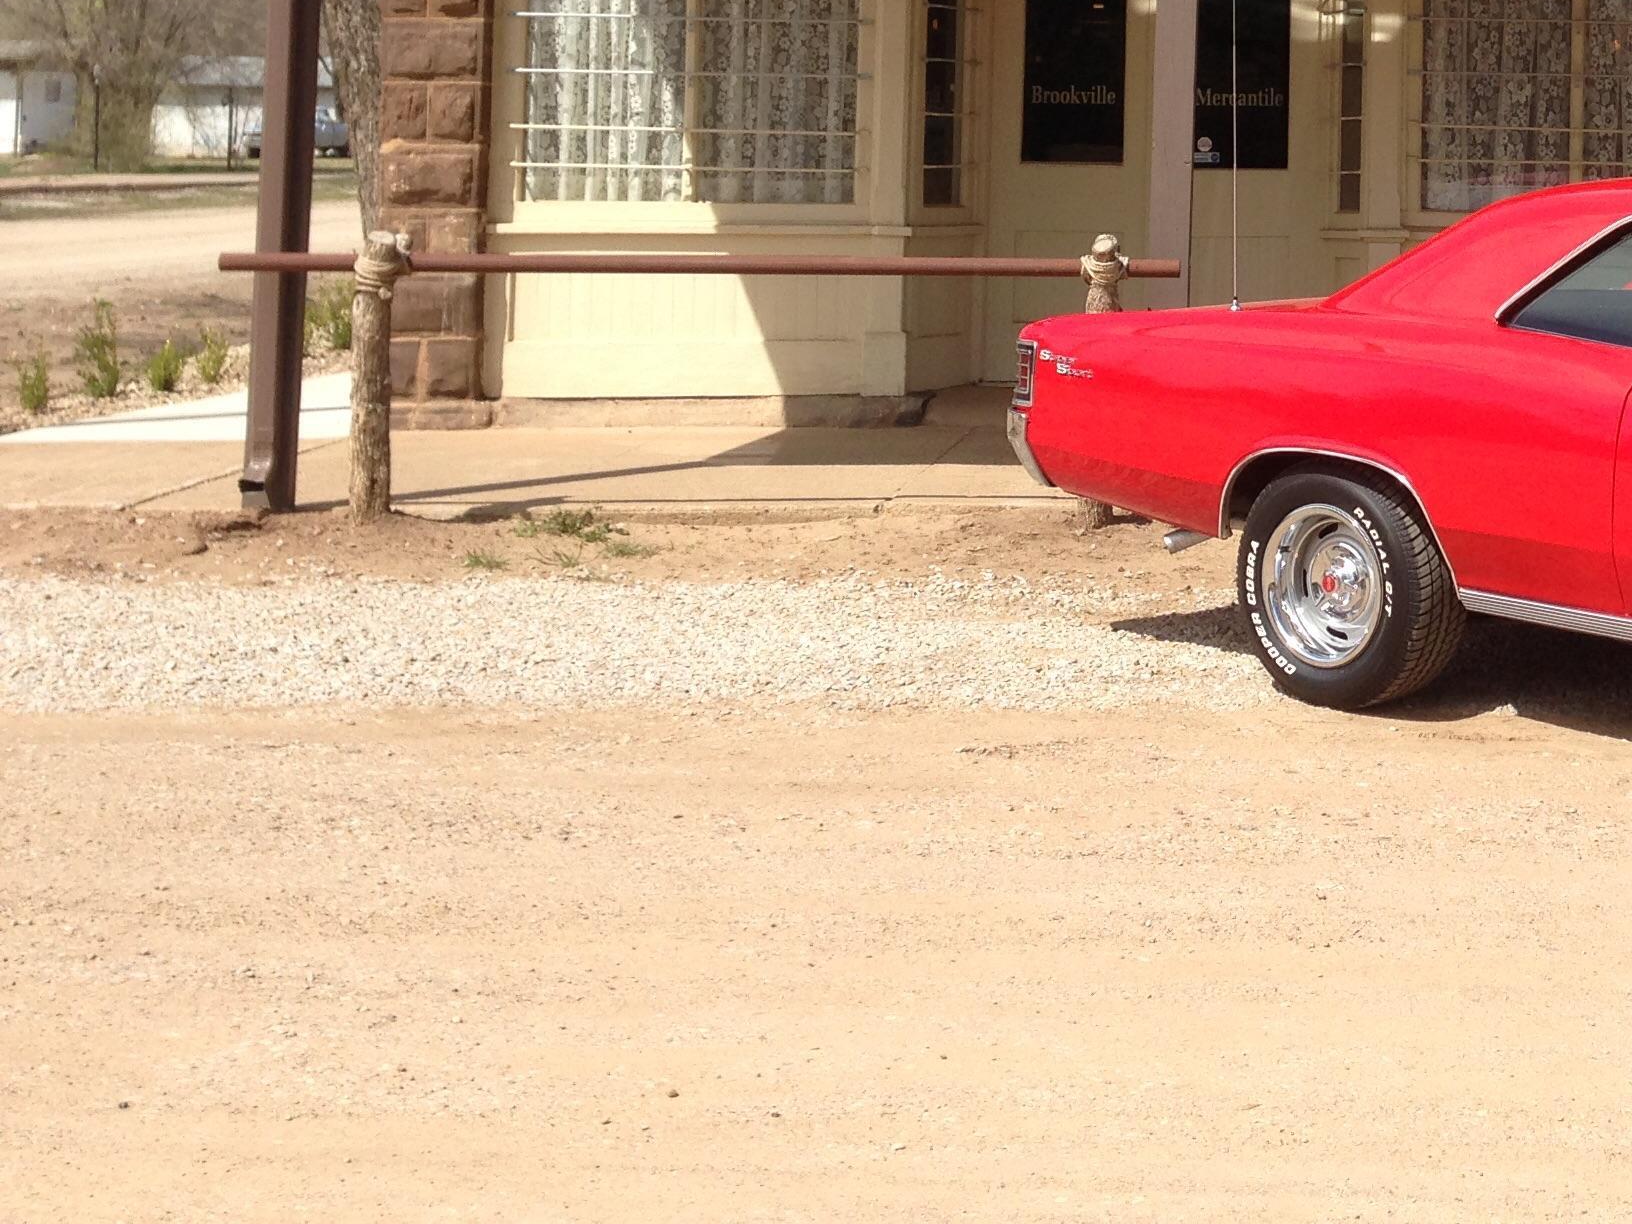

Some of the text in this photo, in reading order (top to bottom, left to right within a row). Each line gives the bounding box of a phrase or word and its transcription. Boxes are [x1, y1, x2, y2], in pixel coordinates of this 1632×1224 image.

[1031, 85, 1284, 107] Brookville Mercantile
[1353, 507, 1390, 576] RADIAL
[1245, 540, 1297, 675] COOPER COBRA
